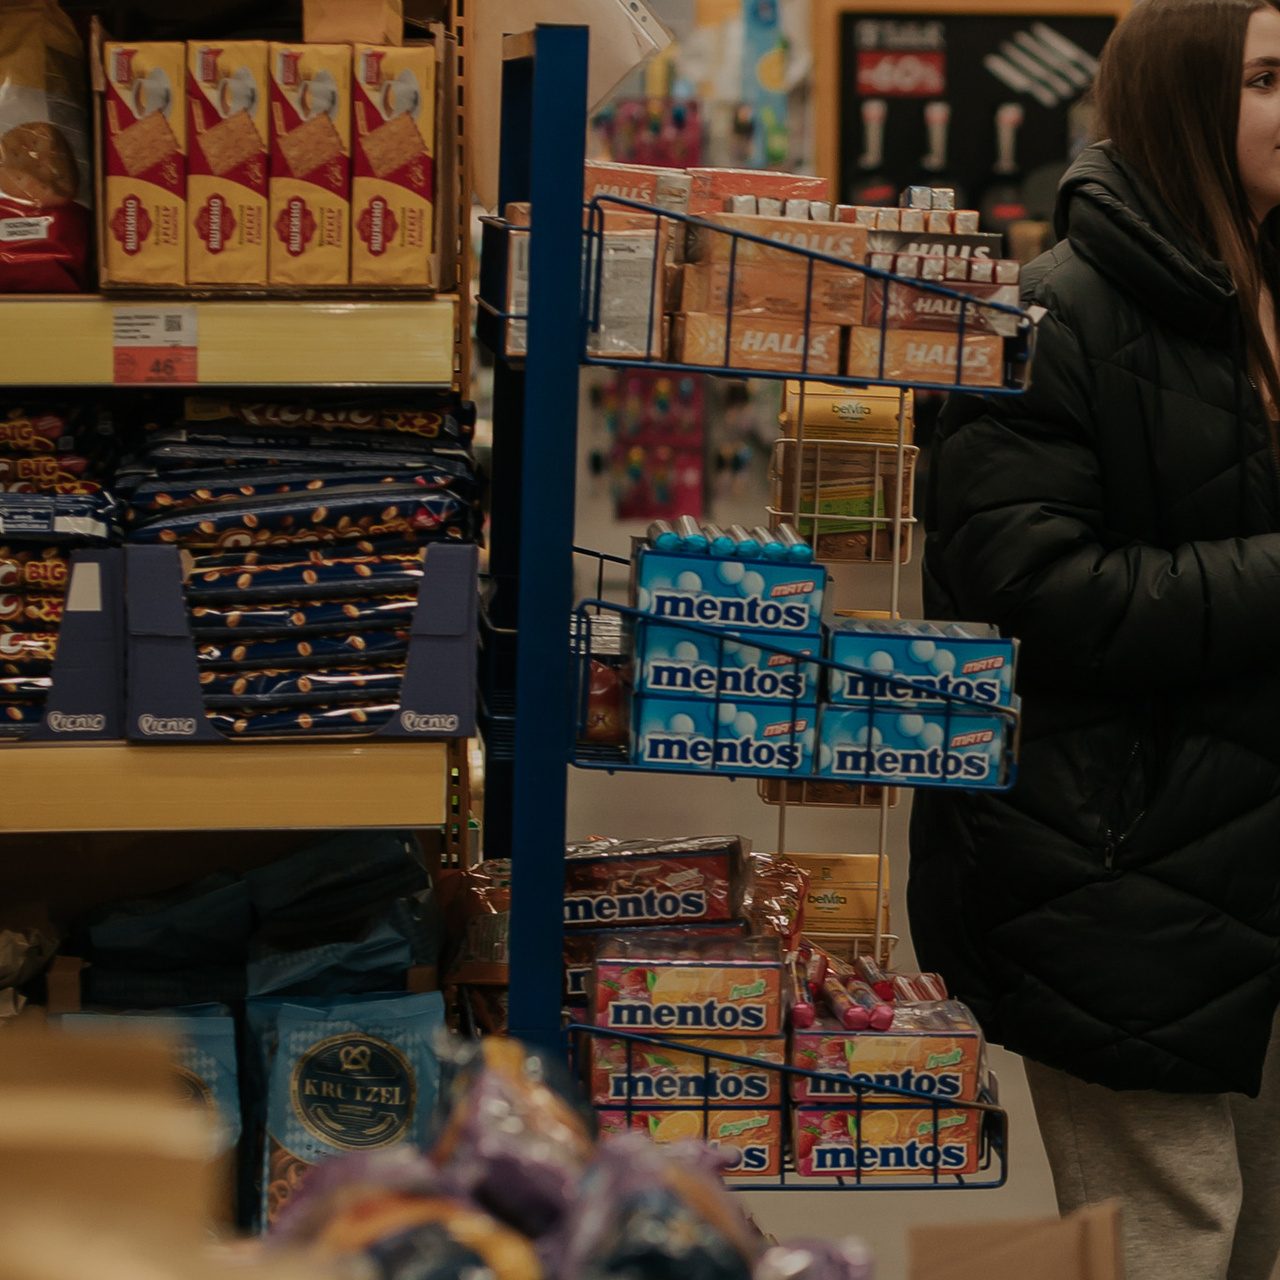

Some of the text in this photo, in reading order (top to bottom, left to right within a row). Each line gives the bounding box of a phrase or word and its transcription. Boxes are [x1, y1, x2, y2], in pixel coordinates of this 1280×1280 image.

[593, 183, 653, 204] HALLS
[124, 199, 138, 250] ЯШКИНО
[208, 198, 222, 250] ЯШКИНО
[289, 201, 303, 252] ЯШКИНО
[370, 201, 384, 252] ЯШКИНО
[771, 231, 854, 261] HALLS
[908, 242, 991, 260] HALLS
[915, 297, 976, 317] HALLS
[740, 329, 829, 358] HALLS
[904, 342, 991, 369] HALLS
[18, 457, 58, 479] BIG
[26, 561, 67, 583] BIG
[653, 592, 809, 629] mentos
[648, 661, 806, 698] mentos
[844, 672, 1000, 705] mentos
[644, 734, 803, 770] mentos
[832, 746, 989, 779] mentos
[563, 887, 706, 923] mentos
[807, 891, 847, 905] belVita
[608, 997, 766, 1030] mentos
[609, 1068, 769, 1101] mentos
[807, 1067, 963, 1098] mentos
[811, 1138, 967, 1172] mentos
